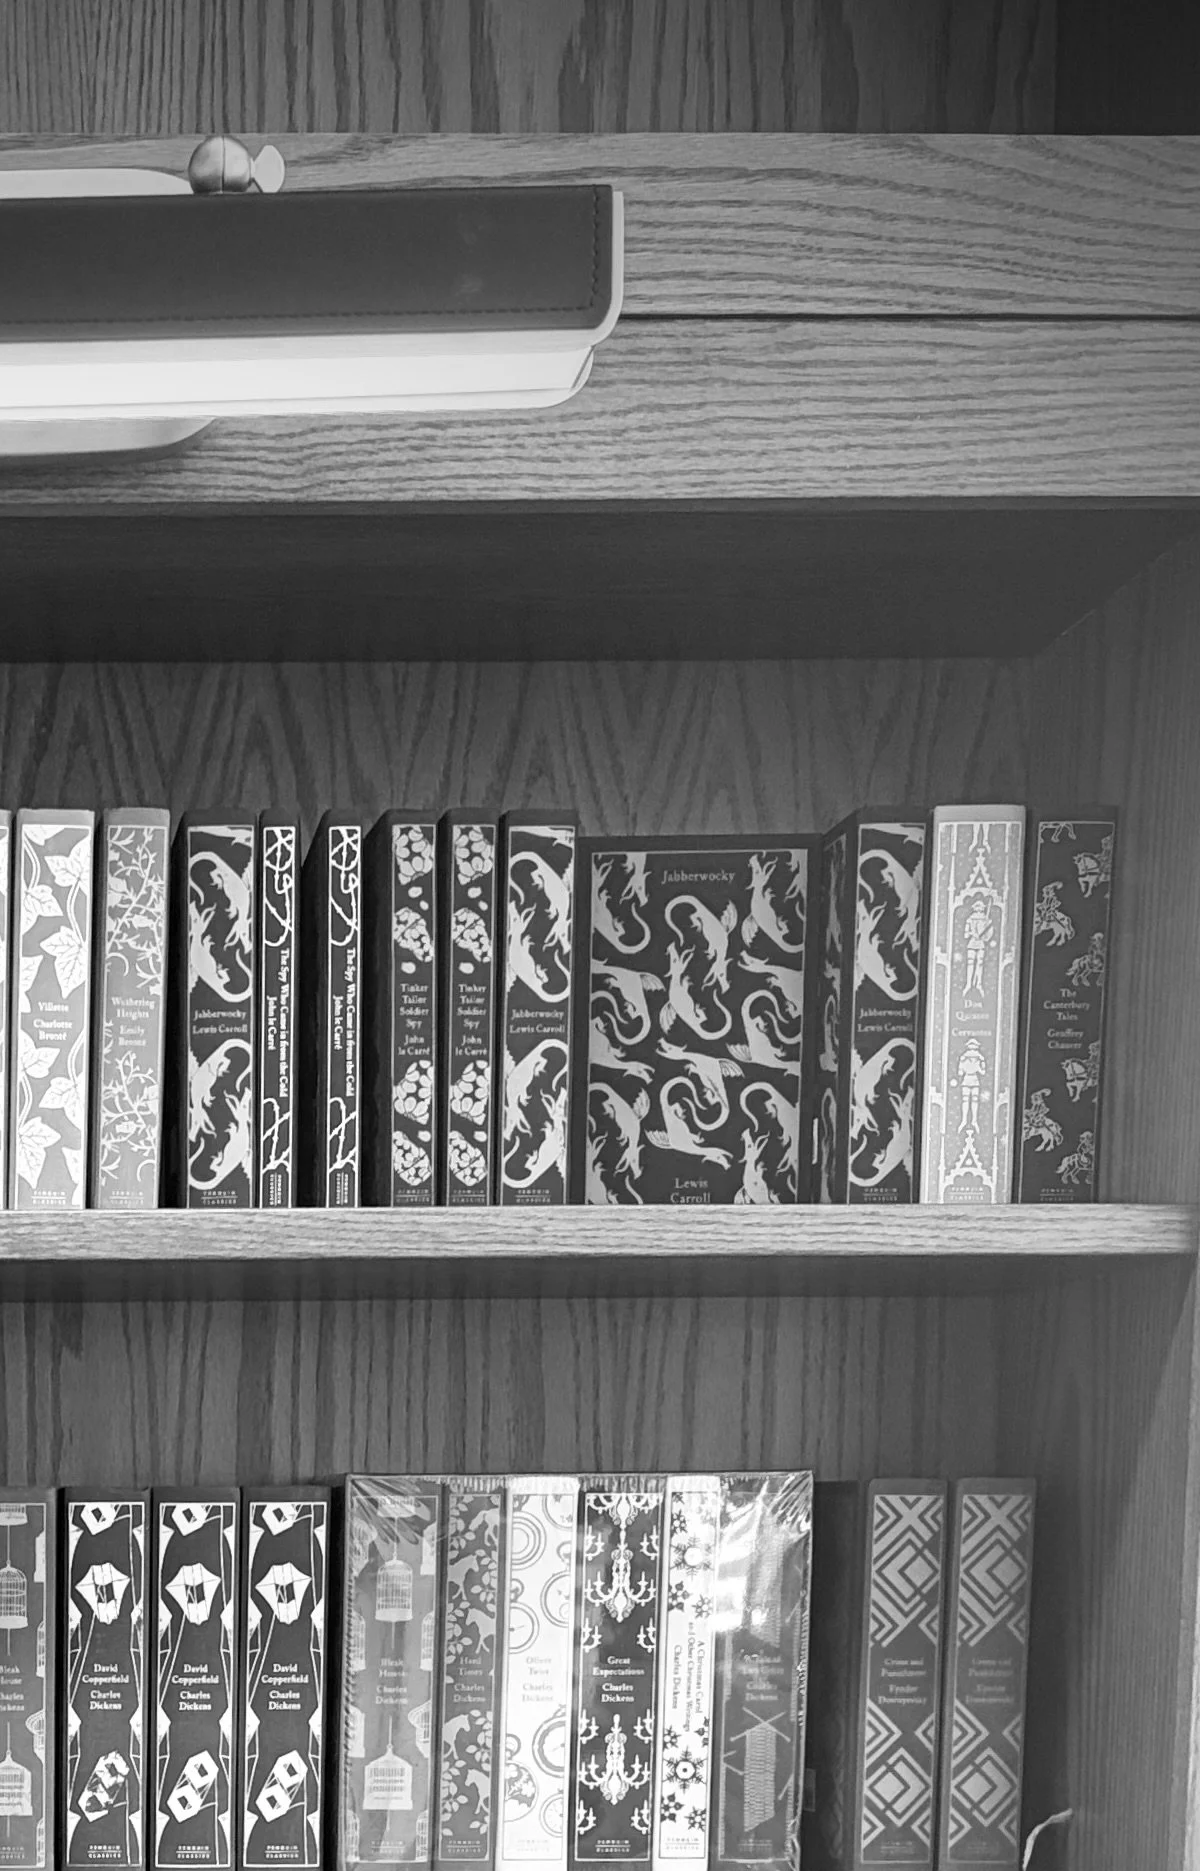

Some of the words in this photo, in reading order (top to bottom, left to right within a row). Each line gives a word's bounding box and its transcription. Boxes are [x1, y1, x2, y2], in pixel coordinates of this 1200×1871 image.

[661, 869, 736, 885] Jabberwocky
[280, 949, 289, 965] The
[278, 966, 289, 982] Spy
[280, 984, 289, 1005] Who
[400, 984, 429, 993] Tinker
[267, 996, 277, 1016] John
[402, 996, 427, 1005] Tailor
[38, 1002, 69, 1012] Villette
[400, 1008, 430, 1017] Soldier
[194, 1009, 247, 1021] Jabberwocky
[280, 1006, 289, 1030] Came
[511, 1009, 564, 1021] Jabberwocky
[33, 1019, 72, 1029] Charlotte
[192, 1025, 217, 1035] Lewis
[219, 1024, 248, 1034] Carroll
[406, 1019, 422, 1030] Spy
[510, 1024, 536, 1034] Lewis
[538, 1024, 566, 1034] Carroll
[280, 1031, 288, 1039] in
[404, 1034, 425, 1046] John
[280, 1041, 289, 1061] from
[280, 1062, 288, 1075] the
[280, 1076, 288, 1097] Cold
[675, 1178, 709, 1190] Lewis
[671, 1192, 712, 1204] Carroll
[94, 1664, 118, 1673] David
[82, 1675, 129, 1686] Copperfield
[90, 1691, 120, 1700] Charles
[90, 1701, 121, 1711] Dickens
